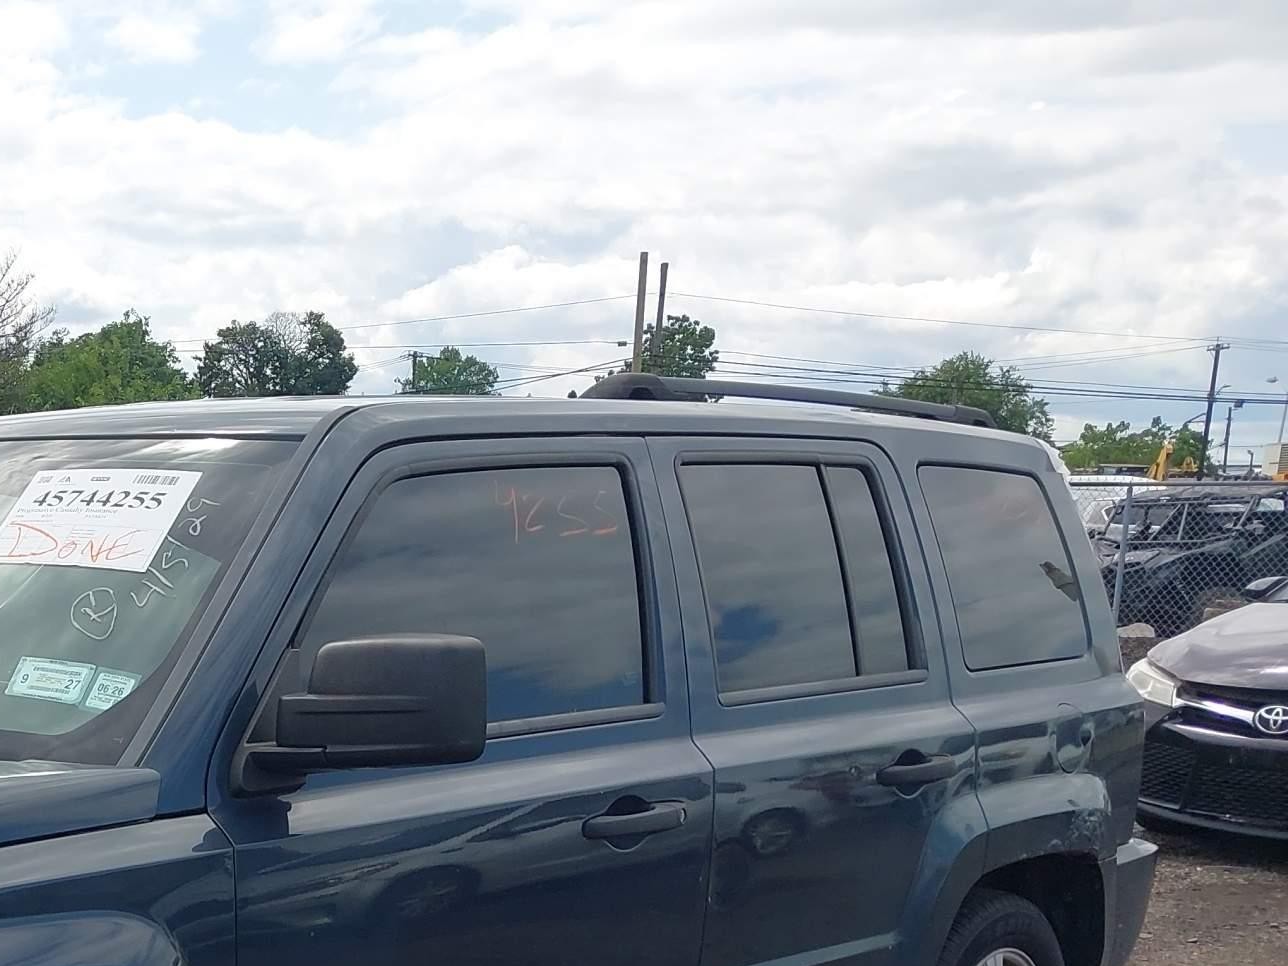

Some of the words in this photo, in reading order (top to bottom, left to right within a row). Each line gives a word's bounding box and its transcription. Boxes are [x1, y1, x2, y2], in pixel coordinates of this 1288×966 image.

[33, 490, 168, 509] 45744255
[20, 673, 30, 684] 9
[64, 679, 81, 690] 27
[97, 683, 110, 692] 06
[111, 686, 125, 696] 26
